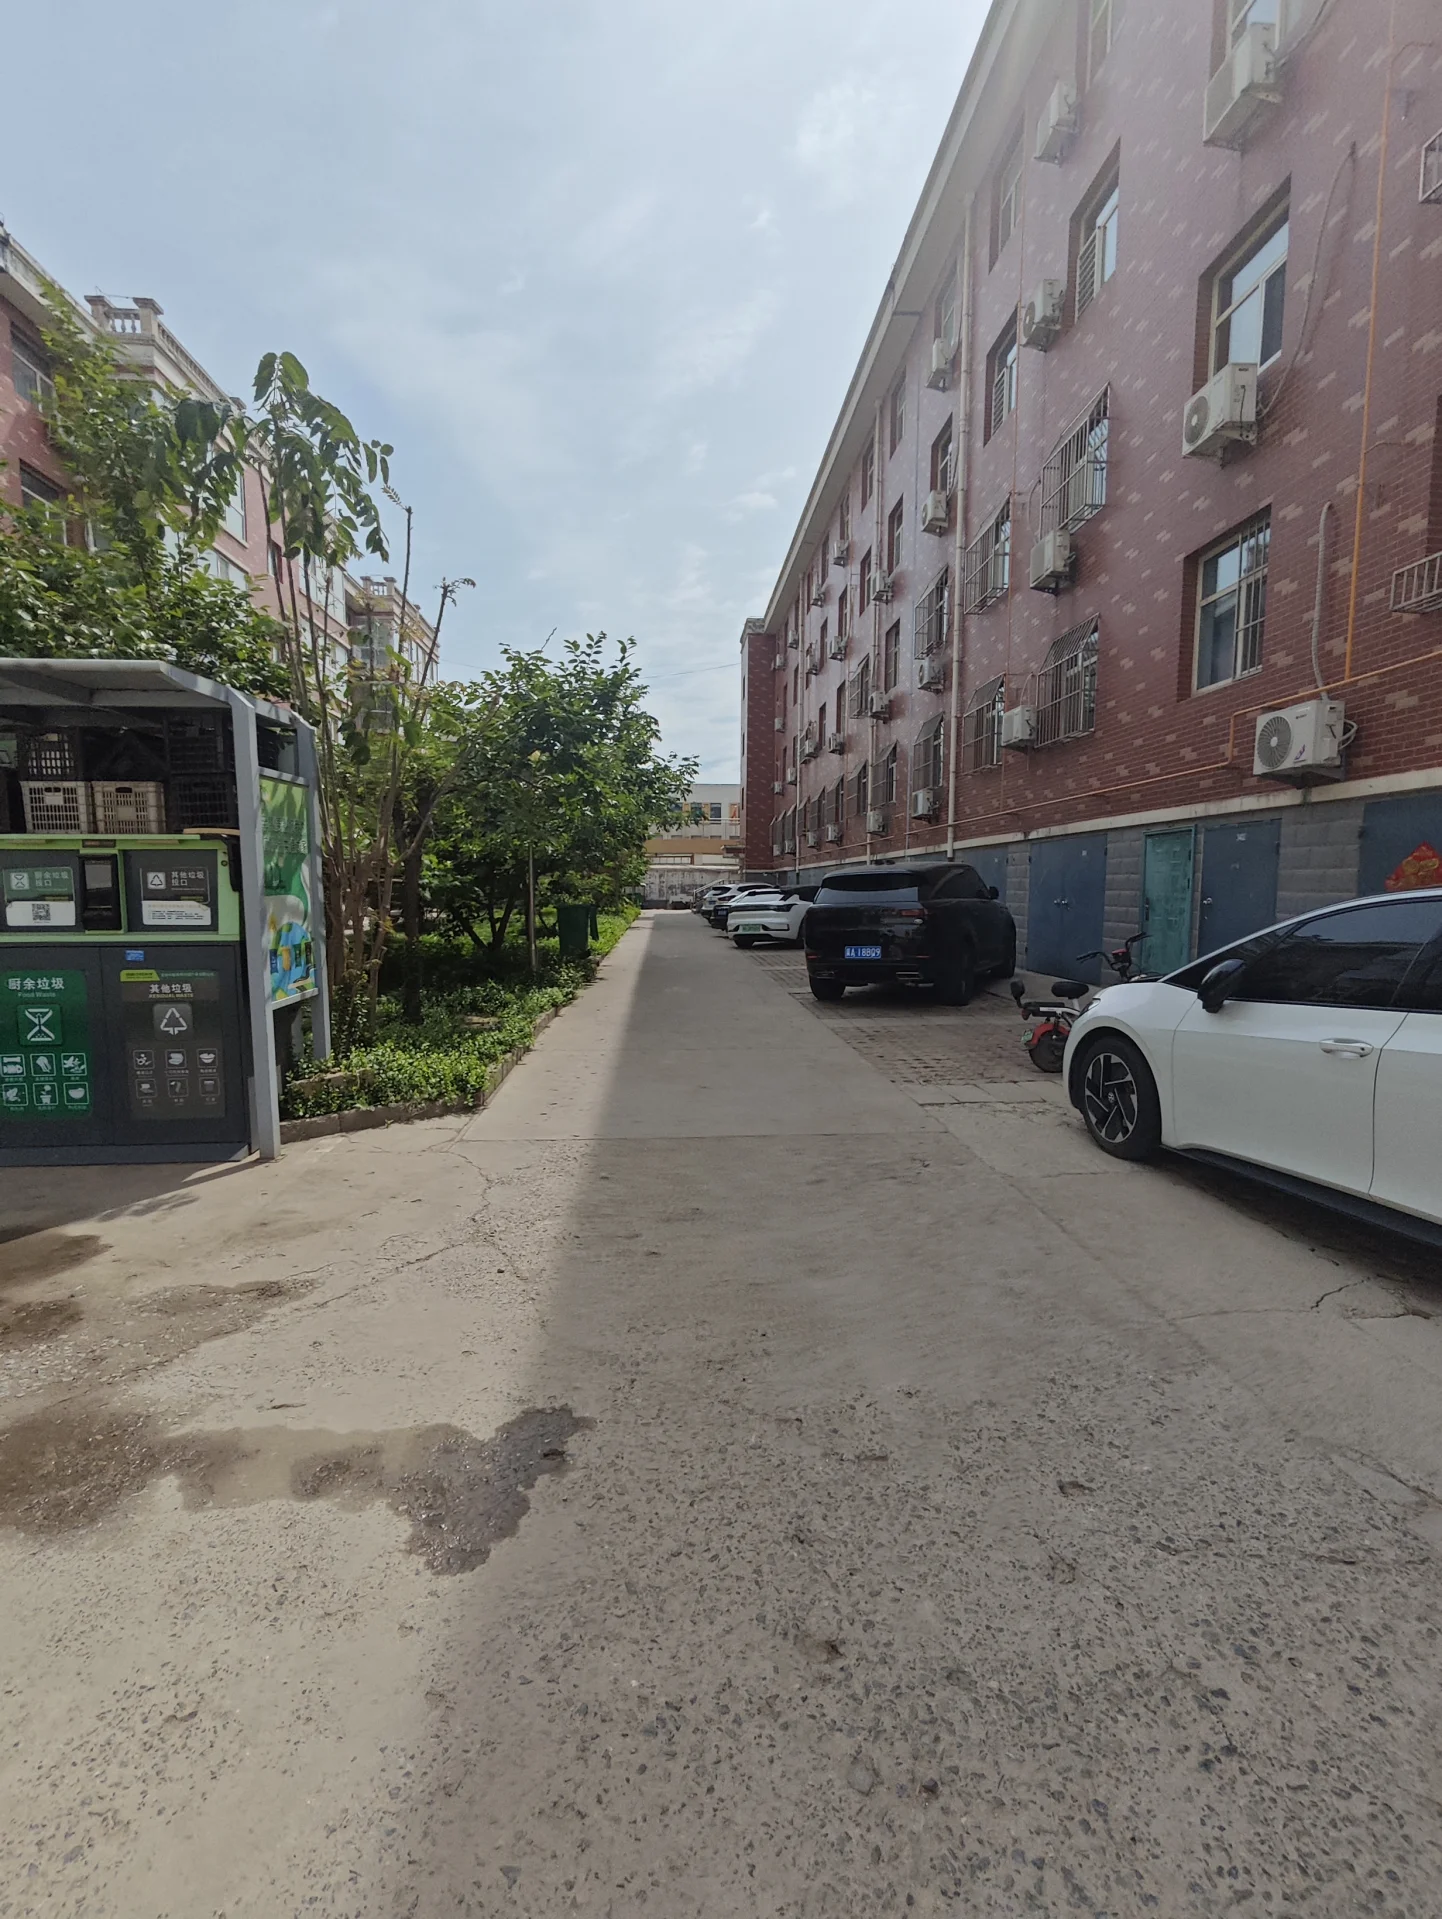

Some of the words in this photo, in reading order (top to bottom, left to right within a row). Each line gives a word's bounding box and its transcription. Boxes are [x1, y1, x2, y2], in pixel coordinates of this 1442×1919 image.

[171, 871, 205, 879] 其他垃圾
[8, 977, 65, 990] 厨余垃圾
[149, 983, 193, 993] 其他垃圾
